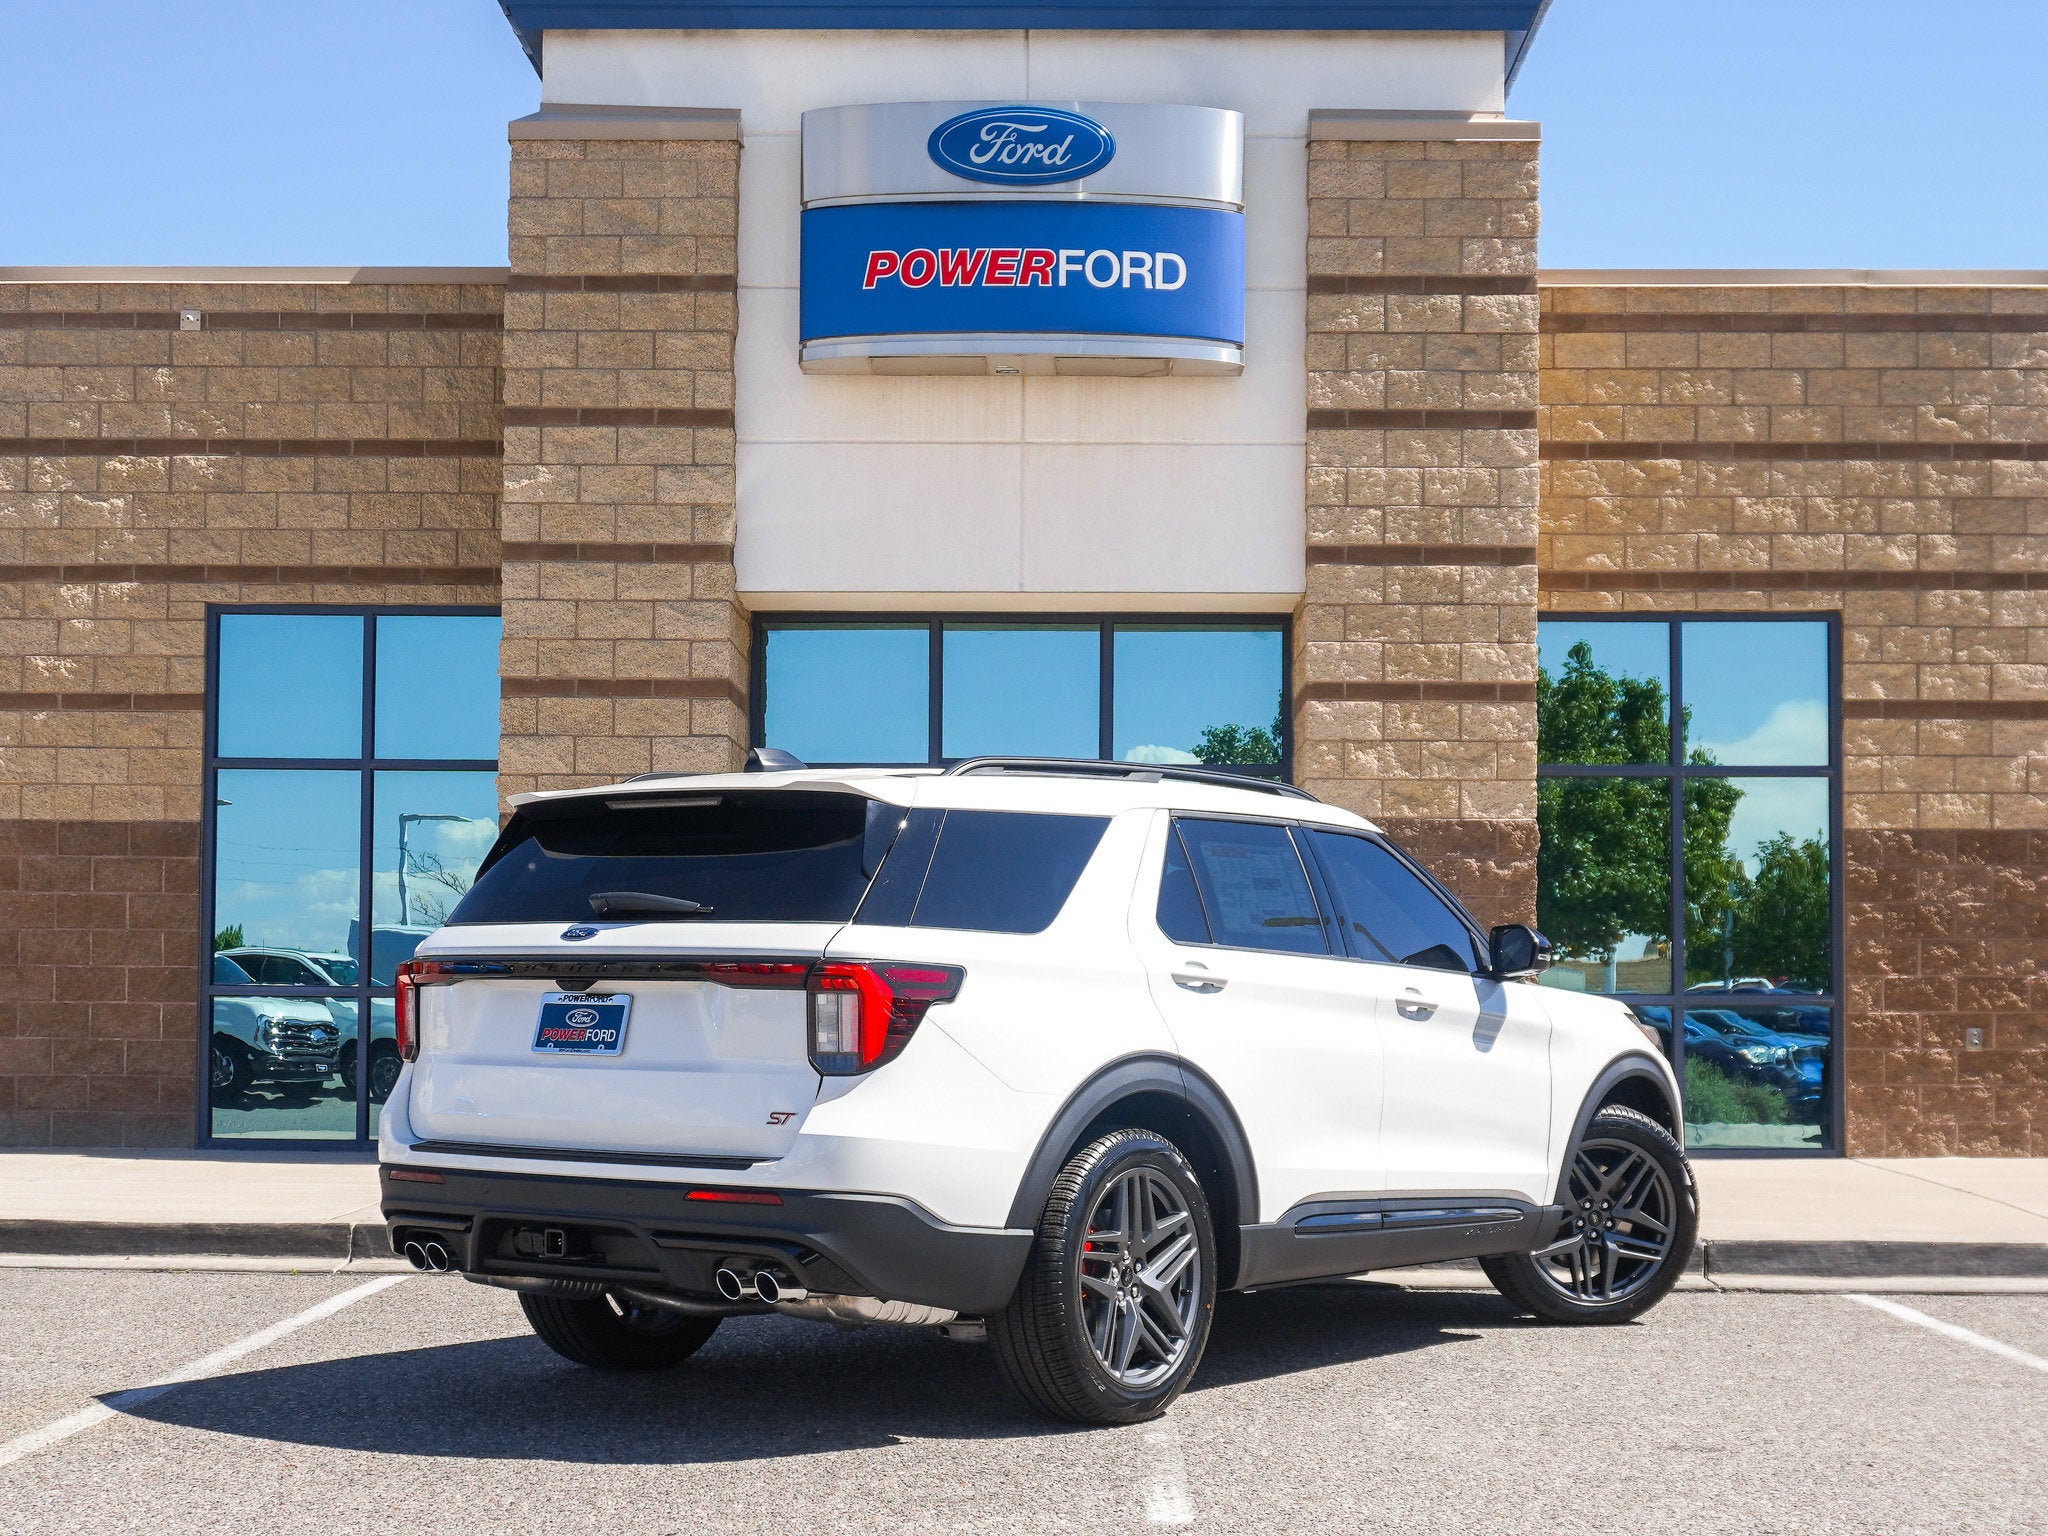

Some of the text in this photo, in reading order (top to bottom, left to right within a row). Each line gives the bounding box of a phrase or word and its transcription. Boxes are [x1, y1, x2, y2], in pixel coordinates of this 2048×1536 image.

[969, 121, 1074, 165] Ford
[862, 247, 1188, 291] POWERFORD
[572, 1012, 592, 1024] Ford
[541, 1027, 617, 1042] POWERFORD
[766, 1111, 797, 1126] ST
